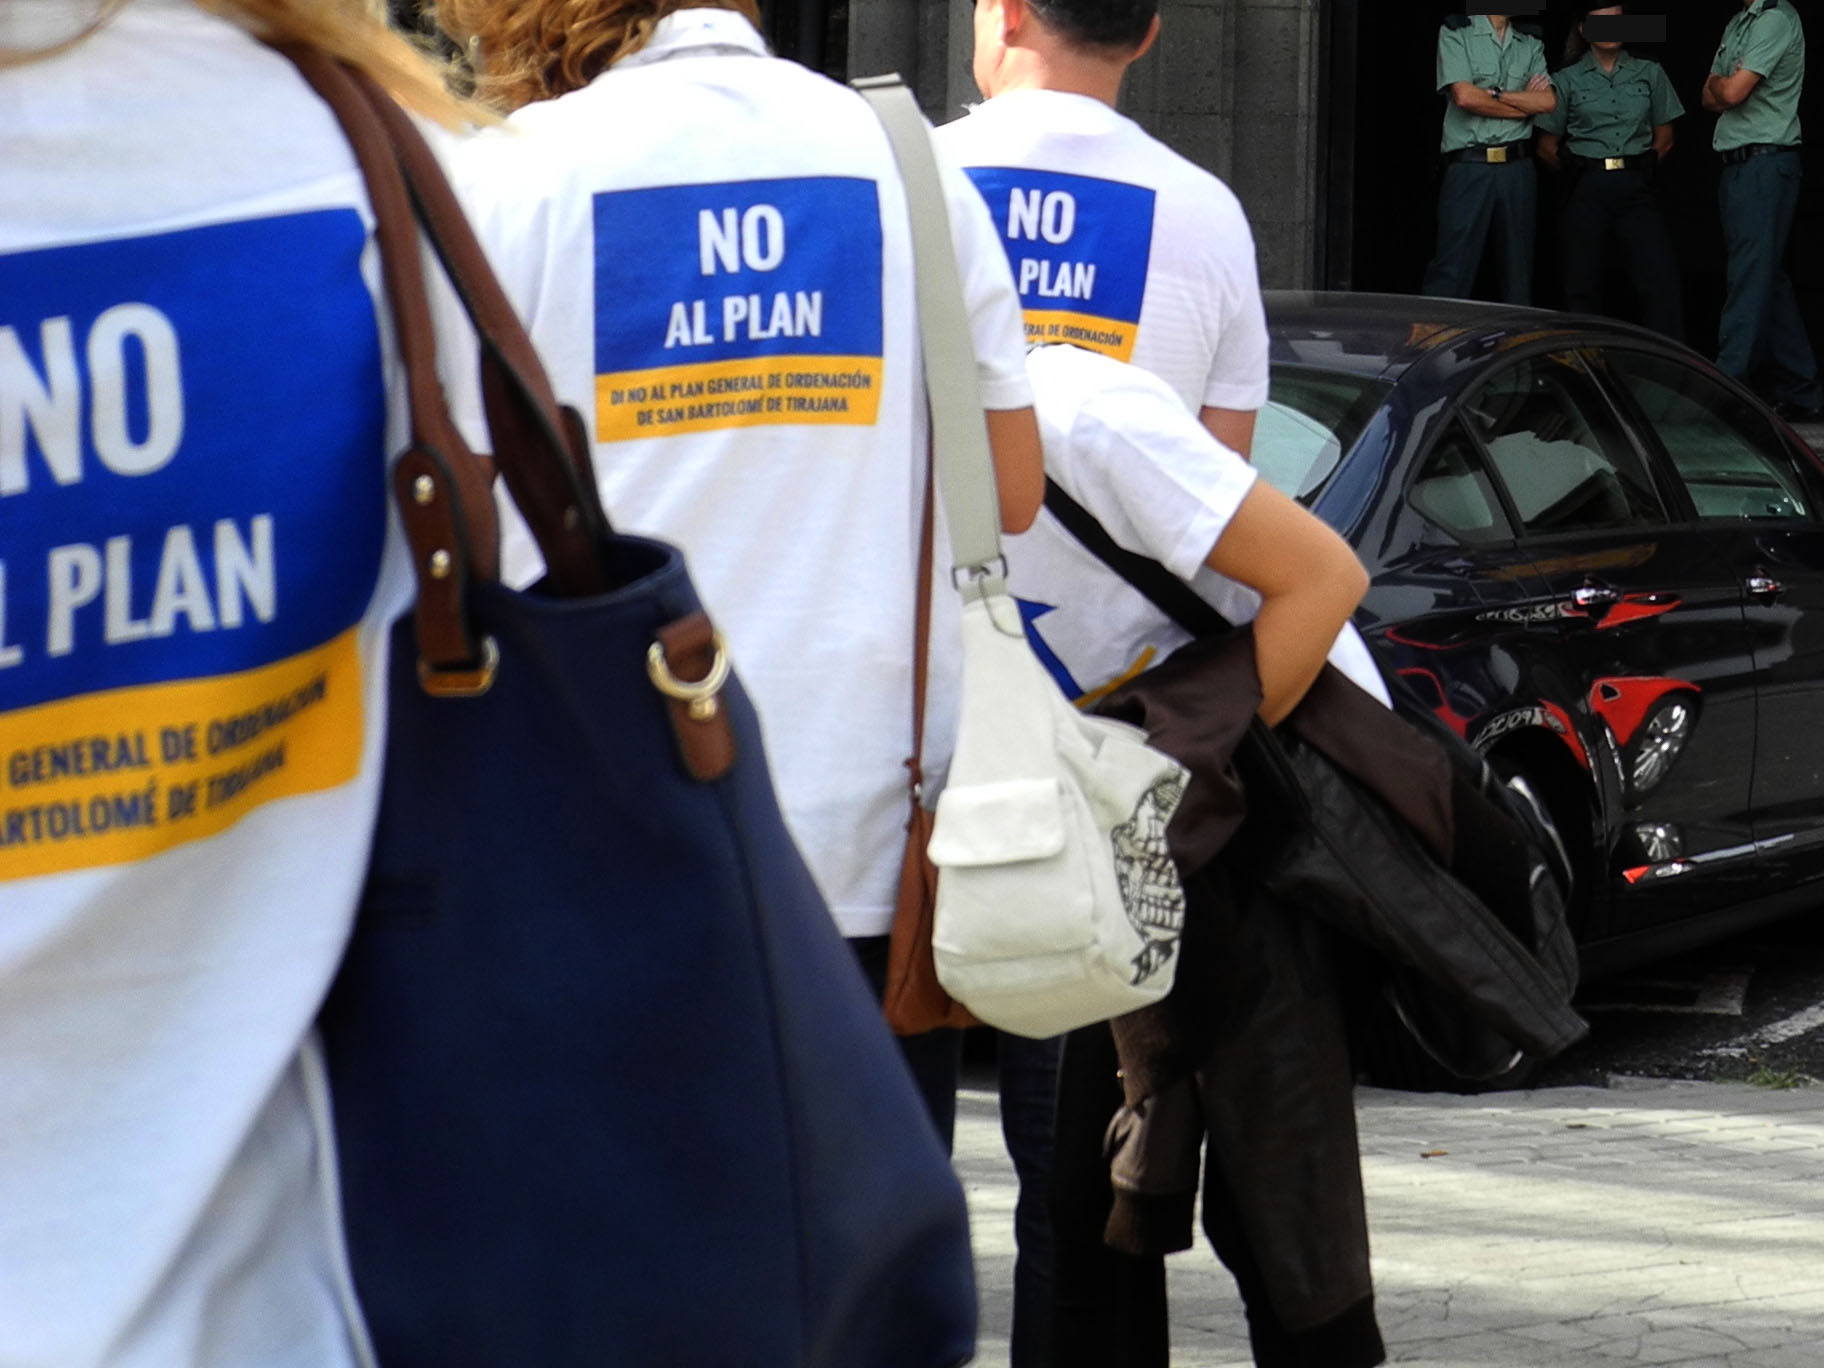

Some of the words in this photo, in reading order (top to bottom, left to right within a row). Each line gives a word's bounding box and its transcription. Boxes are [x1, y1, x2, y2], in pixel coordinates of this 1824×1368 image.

[699, 204, 785, 276] NO
[1007, 187, 1076, 245] NO
[1019, 258, 1095, 300] PLAN
[664, 299, 714, 349] AL
[723, 290, 822, 342] PLAN
[1048, 323, 1059, 336] DE
[1062, 324, 1123, 347] ORDENACIÓN
[0, 302, 184, 498] NO
[611, 389, 624, 406] DI
[628, 387, 647, 403] NO
[651, 384, 666, 401] AL
[669, 381, 704, 399] PLAN
[707, 374, 763, 395] GENERAL
[767, 372, 782, 389] DE
[785, 369, 872, 389] ORDENACIÓN
[637, 409, 653, 427] DE
[657, 407, 684, 424] SAN
[687, 393, 764, 420] BARTOLOMÉ
[766, 396, 782, 413] DE
[786, 396, 848, 413] TIRAJANA
[47, 513, 277, 658] PLAN
[9, 726, 150, 789] GENERAL
[160, 721, 198, 763] DE
[0, 775, 157, 846] RTOLOMÉ
[168, 782, 197, 822] DE
